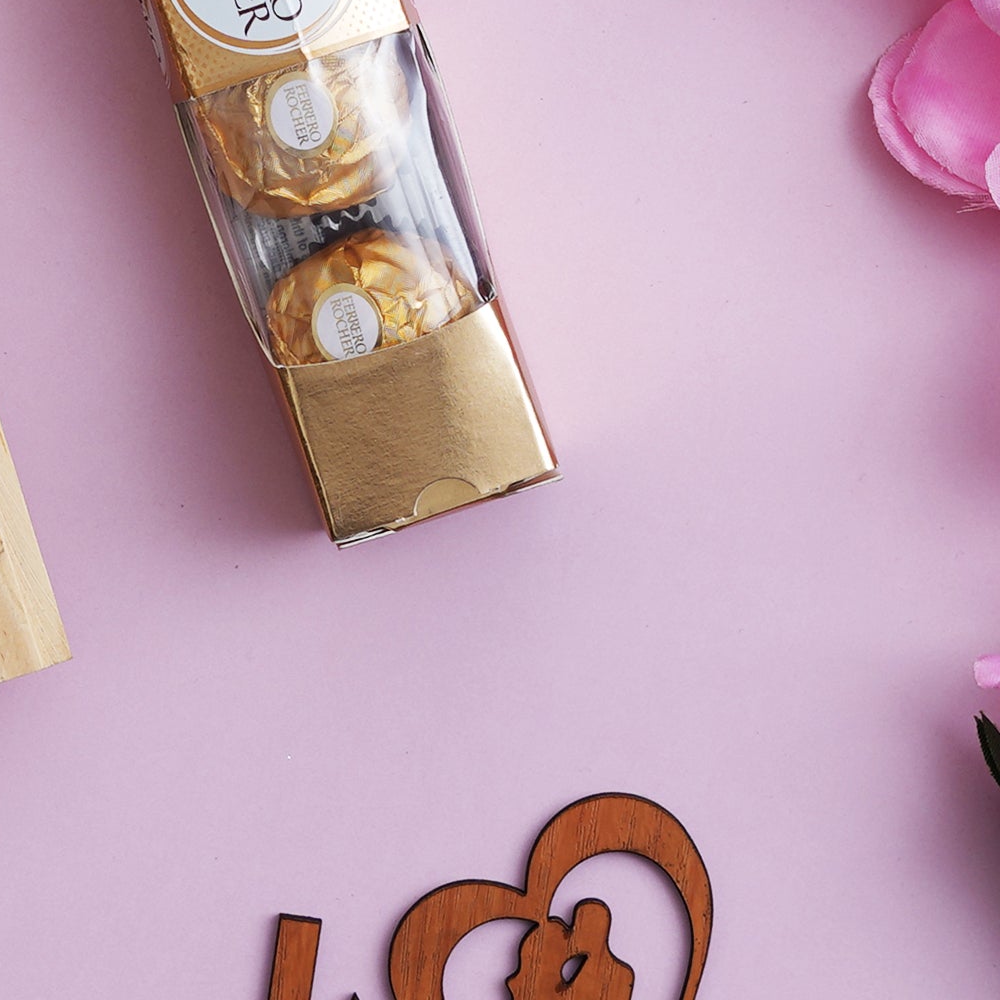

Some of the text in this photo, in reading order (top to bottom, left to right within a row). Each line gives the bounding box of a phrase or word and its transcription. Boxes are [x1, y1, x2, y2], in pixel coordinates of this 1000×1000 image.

[283, 87, 309, 146] ROCHER
[295, 84, 321, 142] FERRERO
[330, 298, 355, 358] ROCHER
[342, 295, 367, 355] FERRERO
